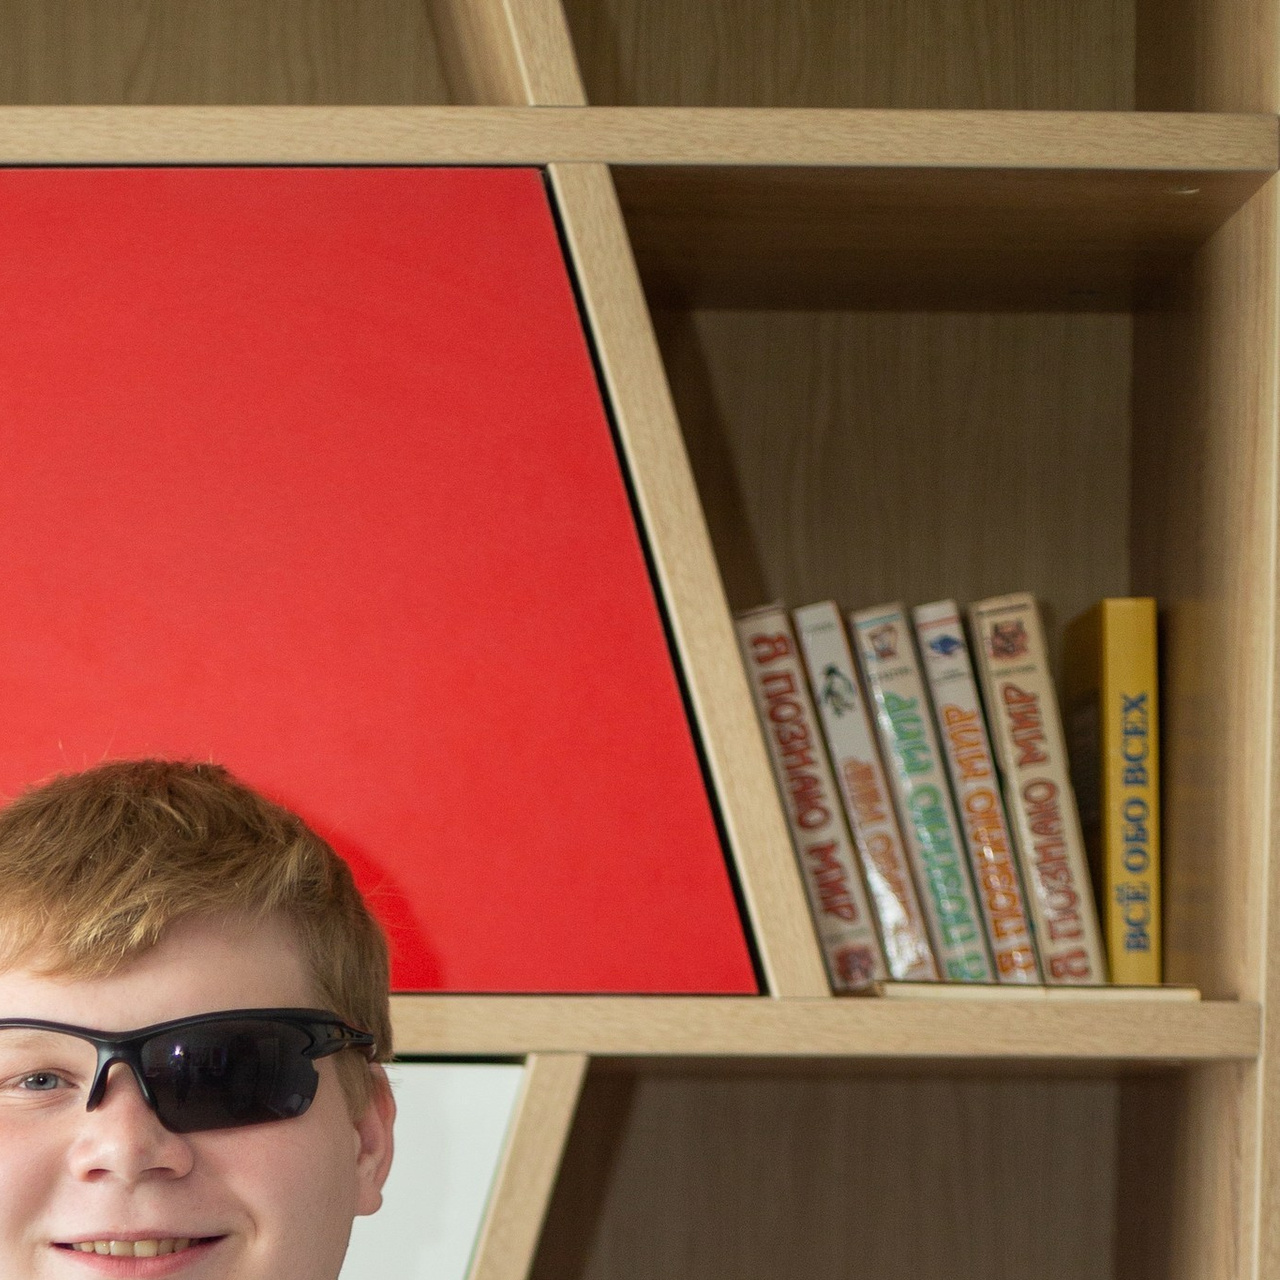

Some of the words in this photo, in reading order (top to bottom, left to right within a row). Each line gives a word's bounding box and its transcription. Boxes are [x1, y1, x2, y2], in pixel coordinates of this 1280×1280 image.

[752, 634, 790, 664] Я
[762, 671, 830, 829] ПОЗНАЮ
[880, 692, 934, 774] МИР
[942, 704, 991, 780] МИР
[1002, 683, 1048, 768] МИР
[1122, 692, 1150, 787] ВСЕХ
[966, 789, 1026, 940] ПОЗНАЮ
[1022, 777, 1084, 942] ПОЗНАЮ
[1122, 797, 1151, 875] ОБО
[807, 841, 857, 922] МИР
[1116, 881, 1151, 953] ВСЁ
[1050, 949, 1090, 979] Я
